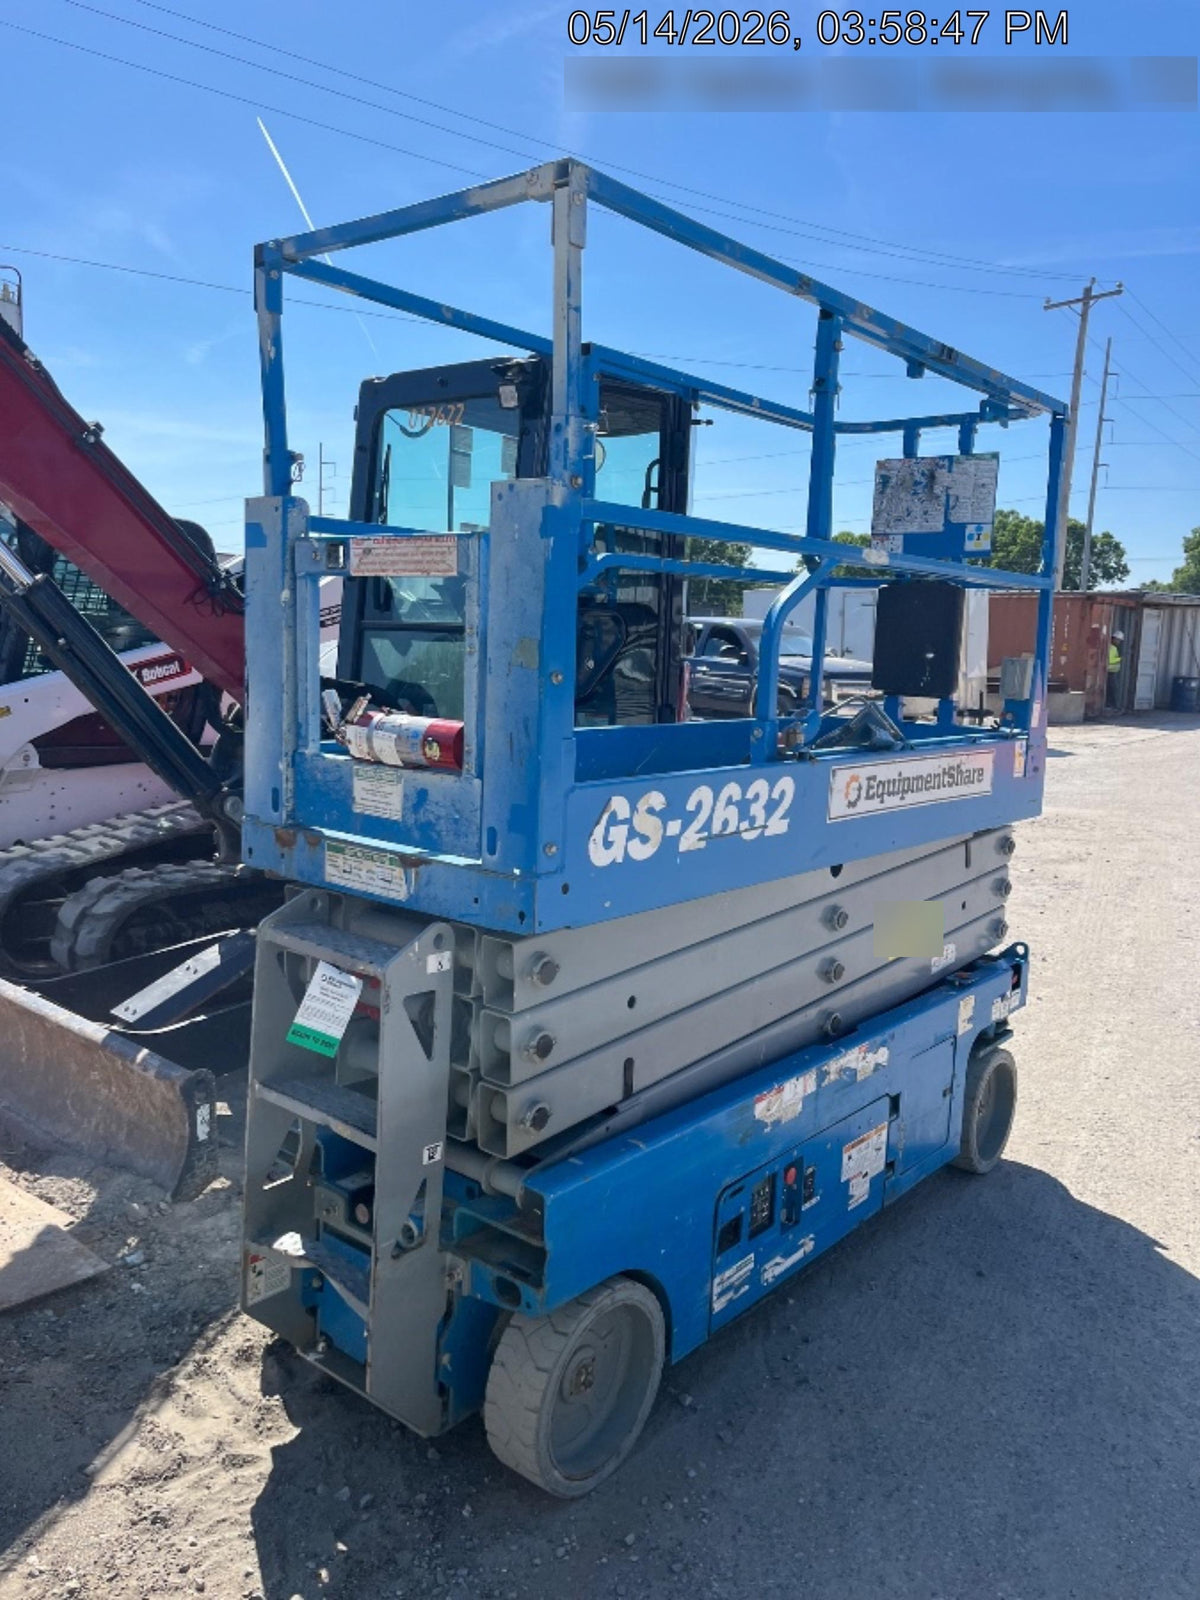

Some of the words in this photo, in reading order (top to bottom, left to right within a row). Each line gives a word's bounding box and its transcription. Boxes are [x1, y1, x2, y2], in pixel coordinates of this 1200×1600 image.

[142, 661, 180, 681] Bobcat
[864, 763, 984, 804] EquipmentShare
[588, 776, 796, 867] GS-2632
